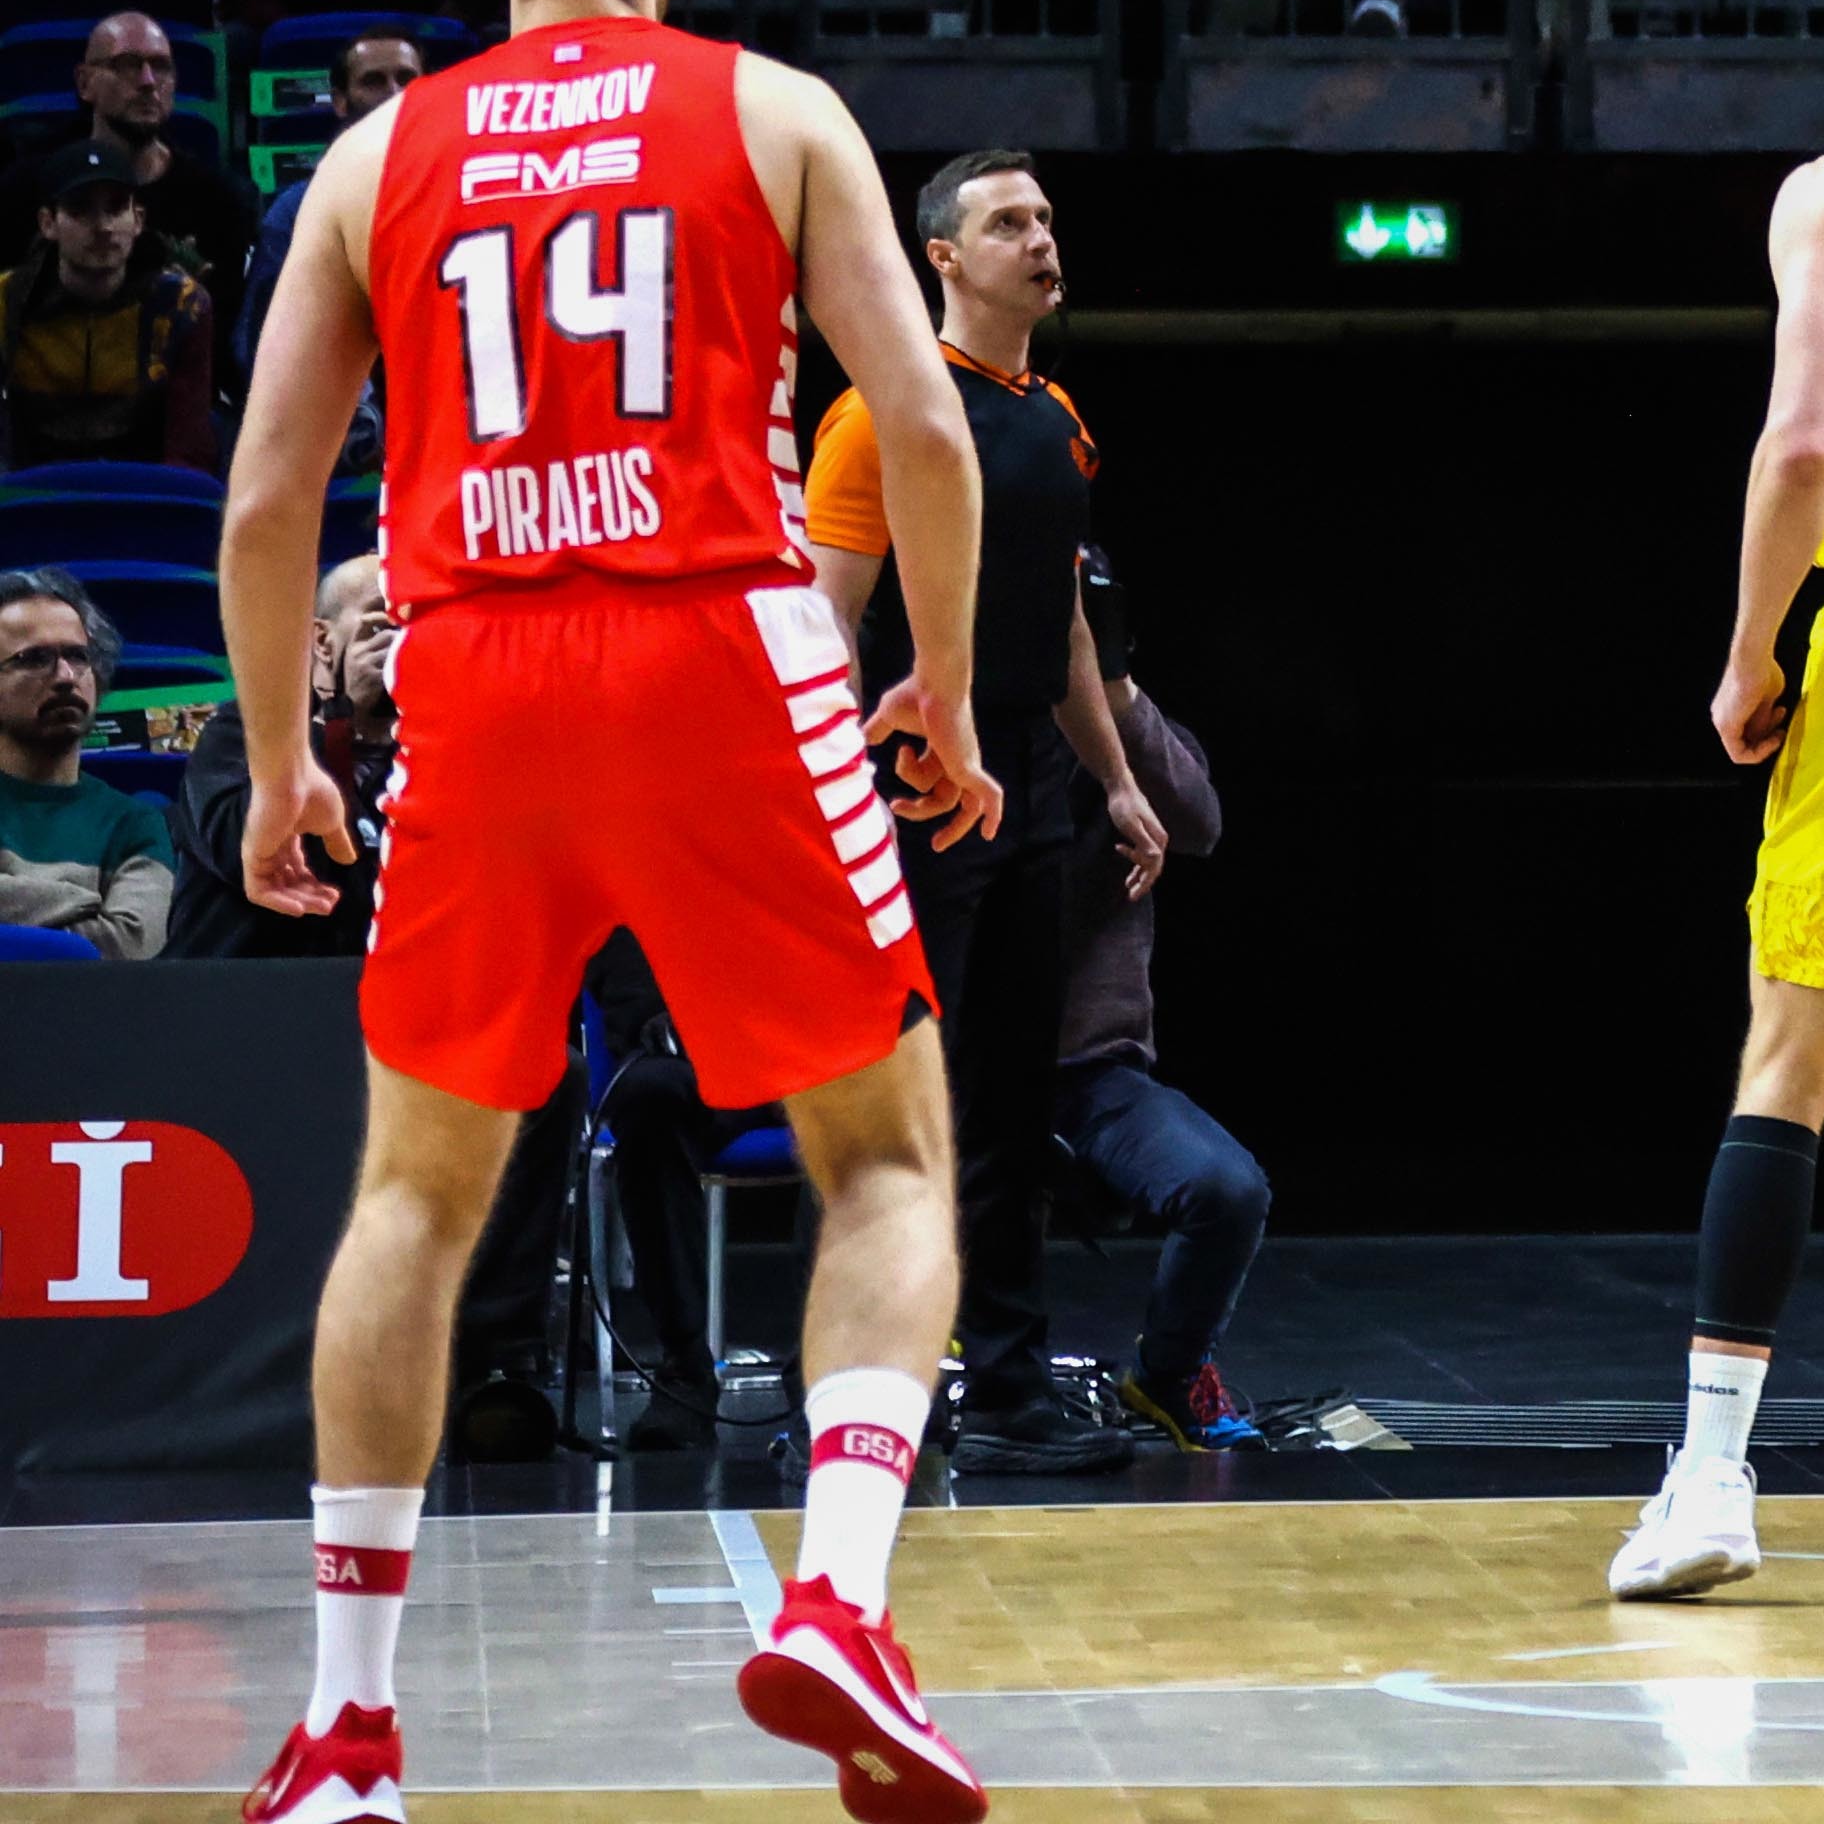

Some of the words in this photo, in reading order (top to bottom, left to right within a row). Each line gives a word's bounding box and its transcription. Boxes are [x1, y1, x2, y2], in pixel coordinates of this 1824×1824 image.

[466, 63, 655, 136] VEZENKOV
[461, 137, 642, 202] FMS
[438, 206, 674, 444] 14
[461, 447, 661, 561] PIRAEUS
[843, 1428, 909, 1482] GSA
[315, 1552, 363, 1585] SA
